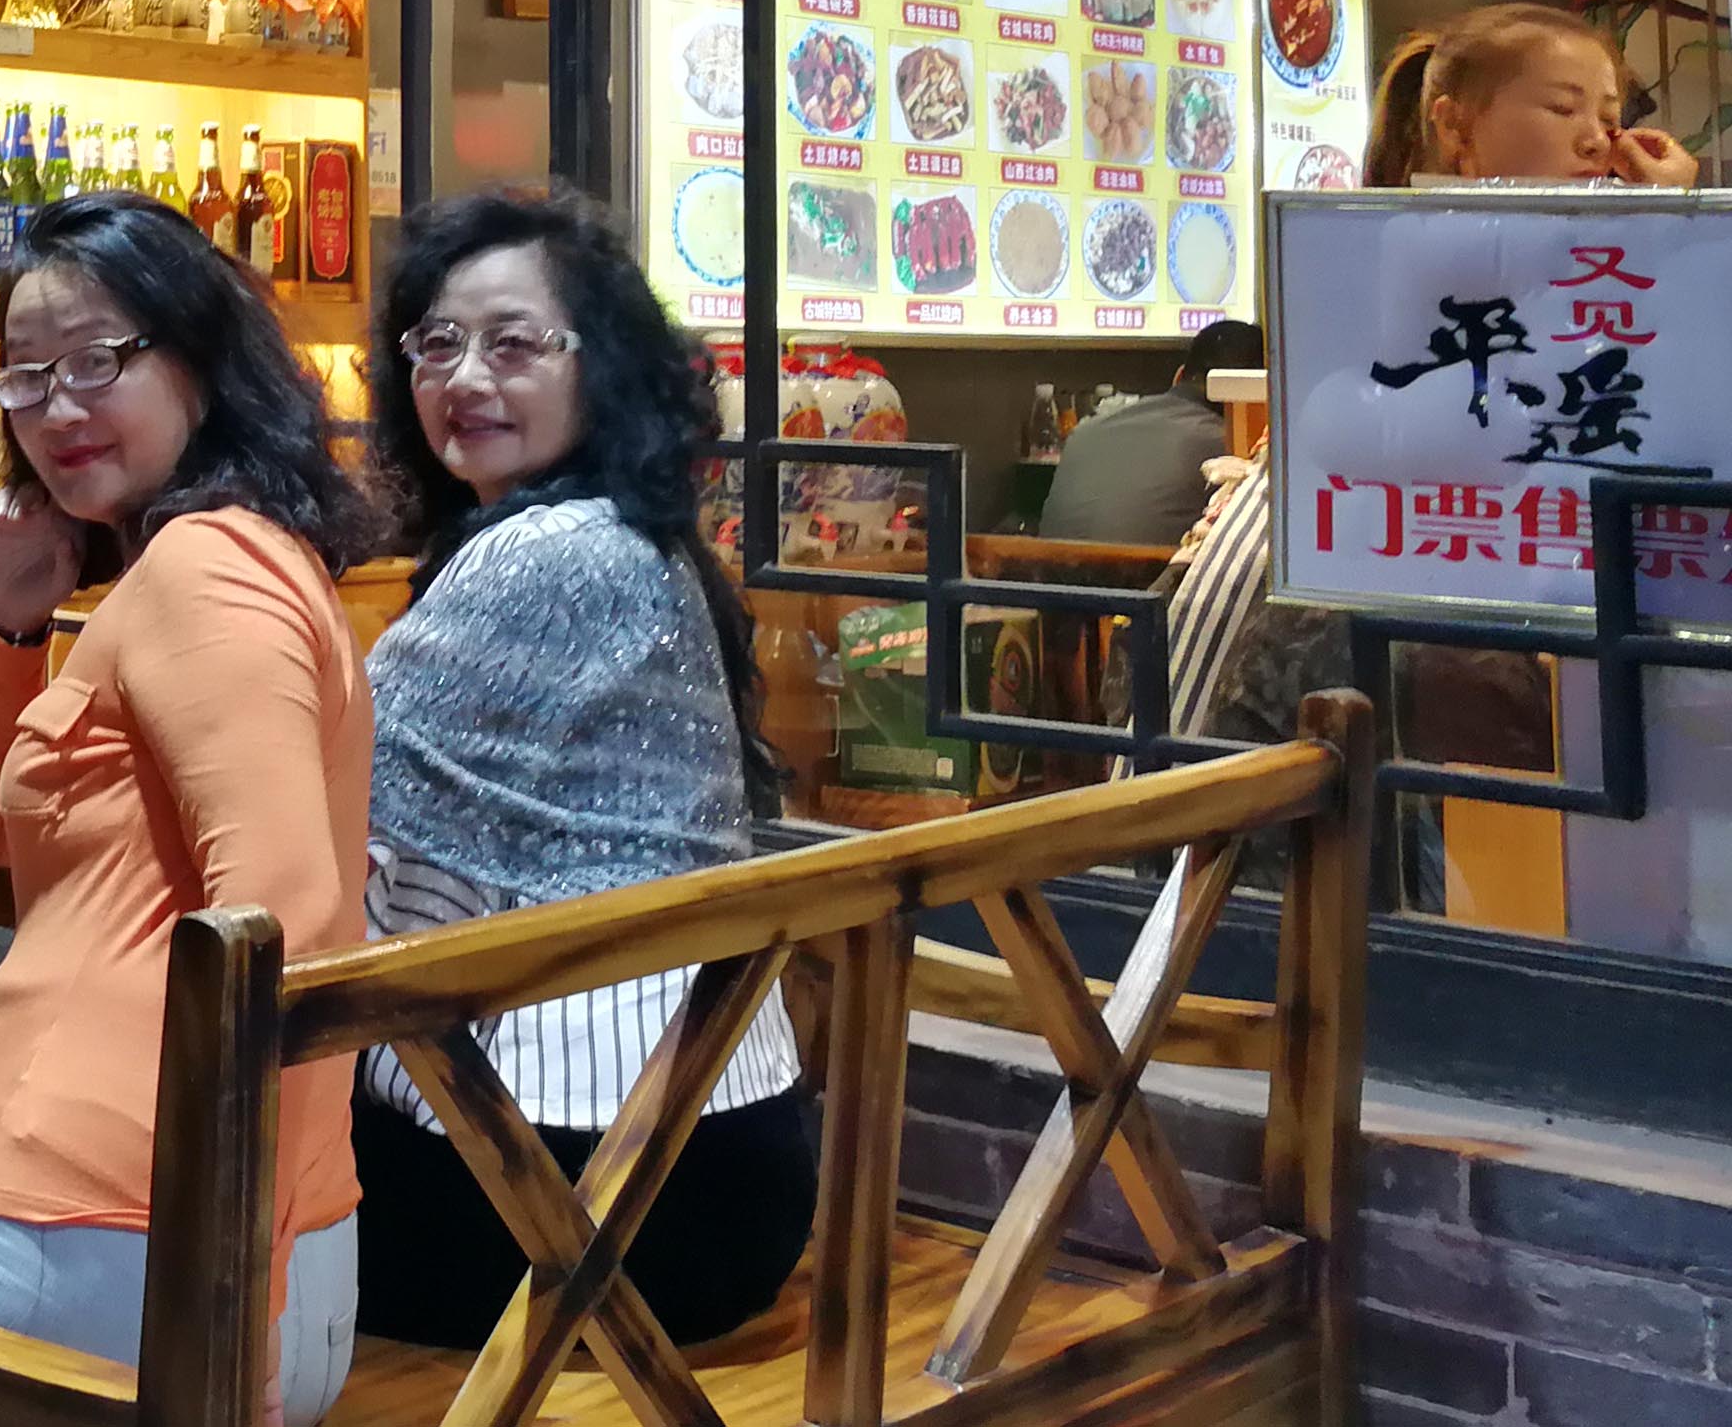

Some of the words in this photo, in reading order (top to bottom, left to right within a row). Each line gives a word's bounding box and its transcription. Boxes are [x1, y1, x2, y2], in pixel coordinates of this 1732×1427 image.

[1550, 246, 1656, 345] 又见
[1370, 295, 1713, 479] 平遥
[1316, 474, 1732, 585] 门票售票
